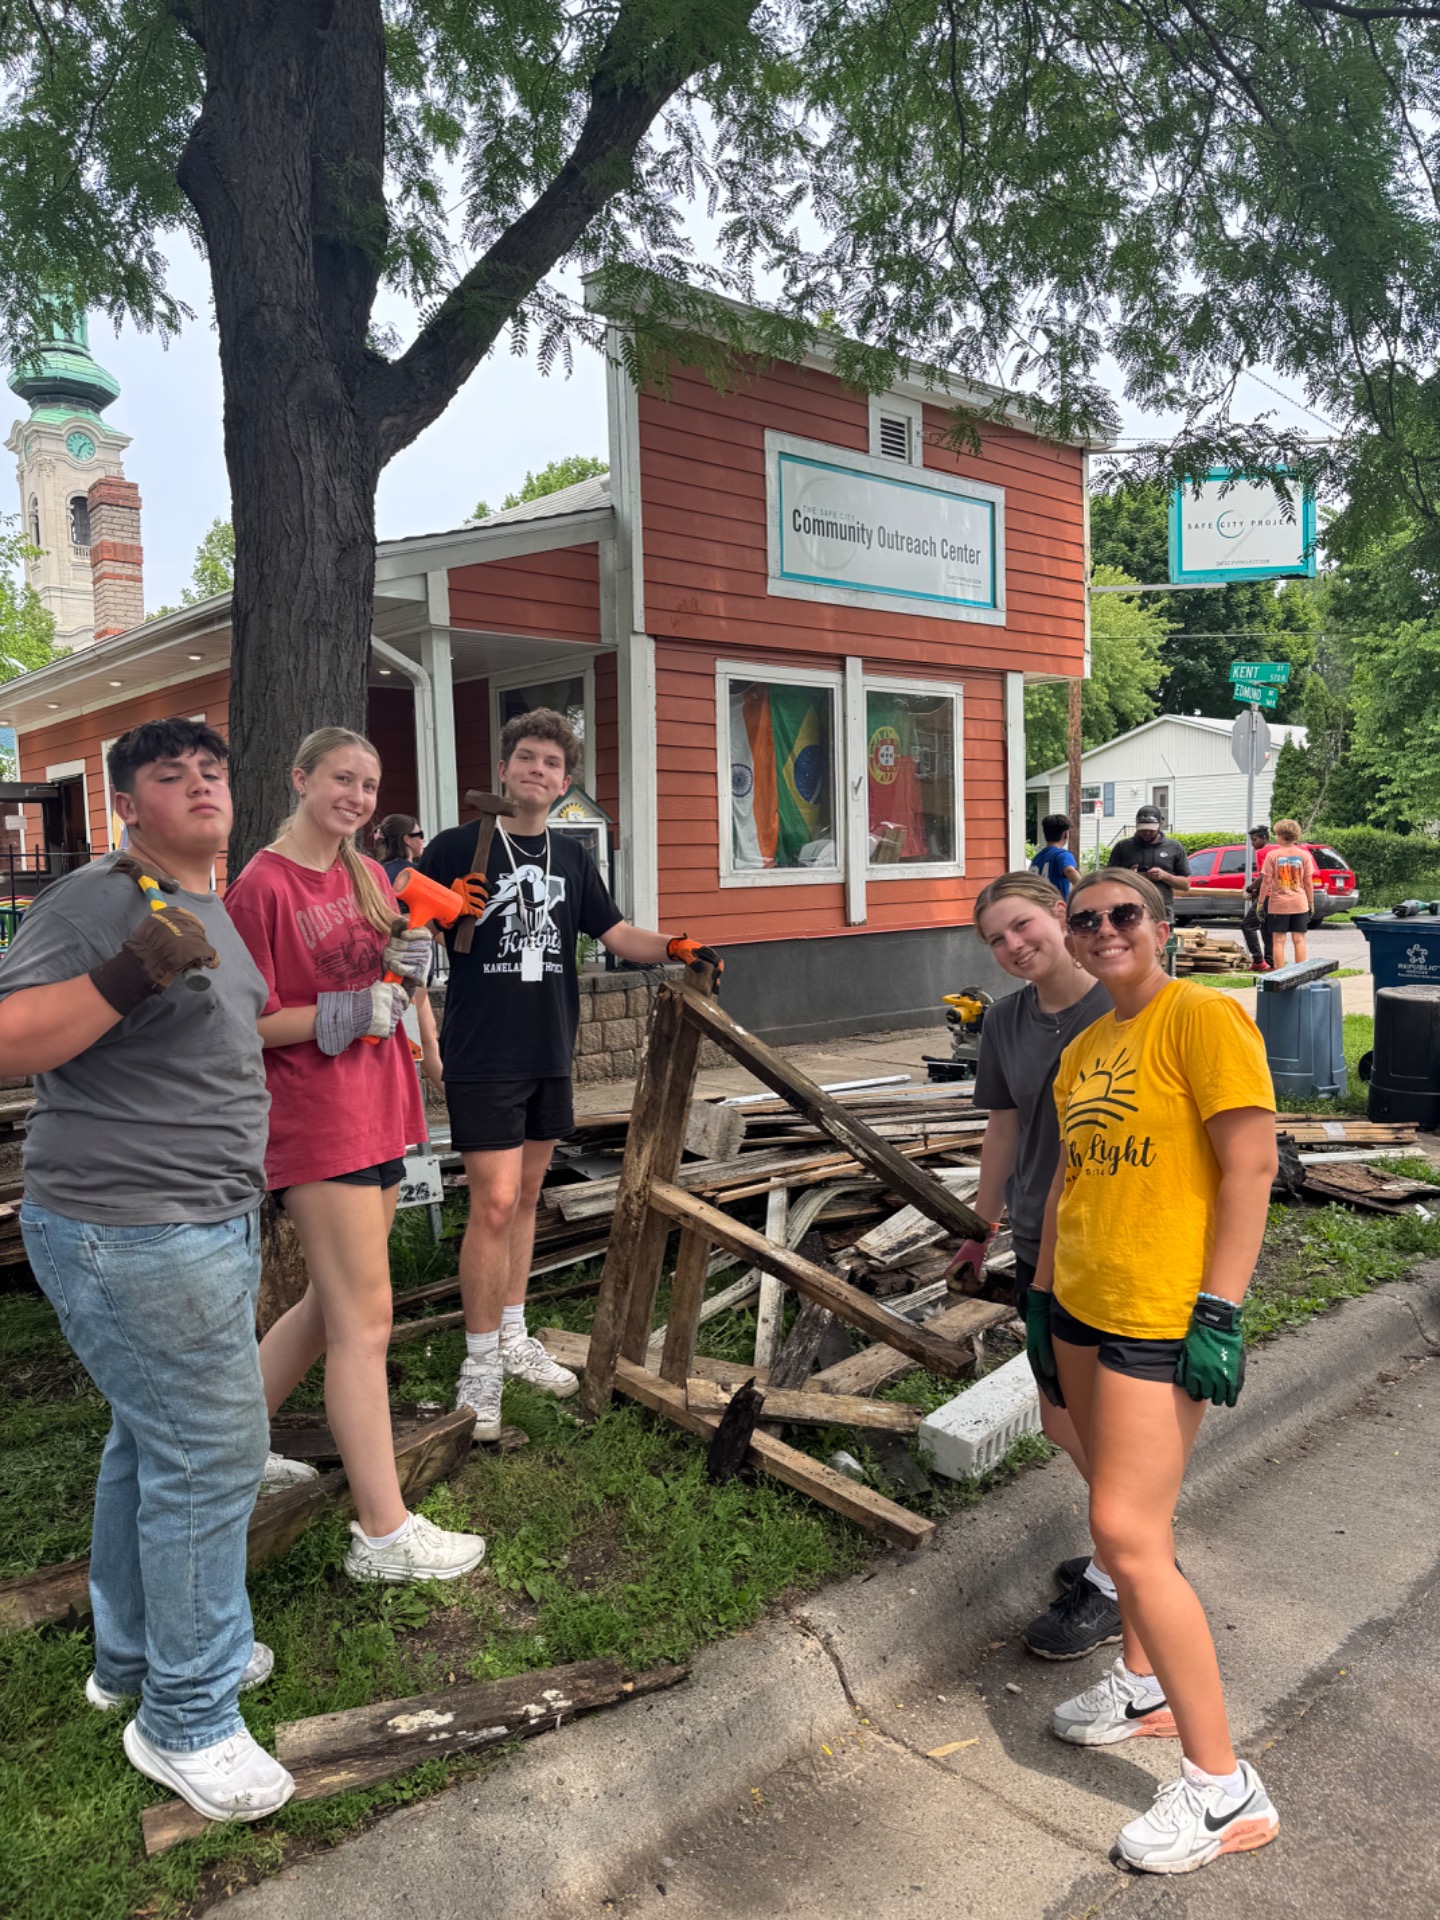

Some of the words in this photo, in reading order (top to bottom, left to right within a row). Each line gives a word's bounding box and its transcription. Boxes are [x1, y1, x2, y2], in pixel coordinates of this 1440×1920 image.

[820, 508, 838, 519] SAFE
[1187, 522, 1213, 530] SAFE
[1250, 518, 1297, 527] PROJE
[792, 508, 874, 551] Community
[877, 525, 937, 558] Outreach
[940, 538, 982, 566] Center
[1232, 665, 1260, 679] KENT
[1235, 684, 1262, 701] EDMUND
[296, 904, 333, 950] OLD
[1398, 962, 1437, 972] REPUBLIC
[1088, 1133, 1157, 1176] Light
